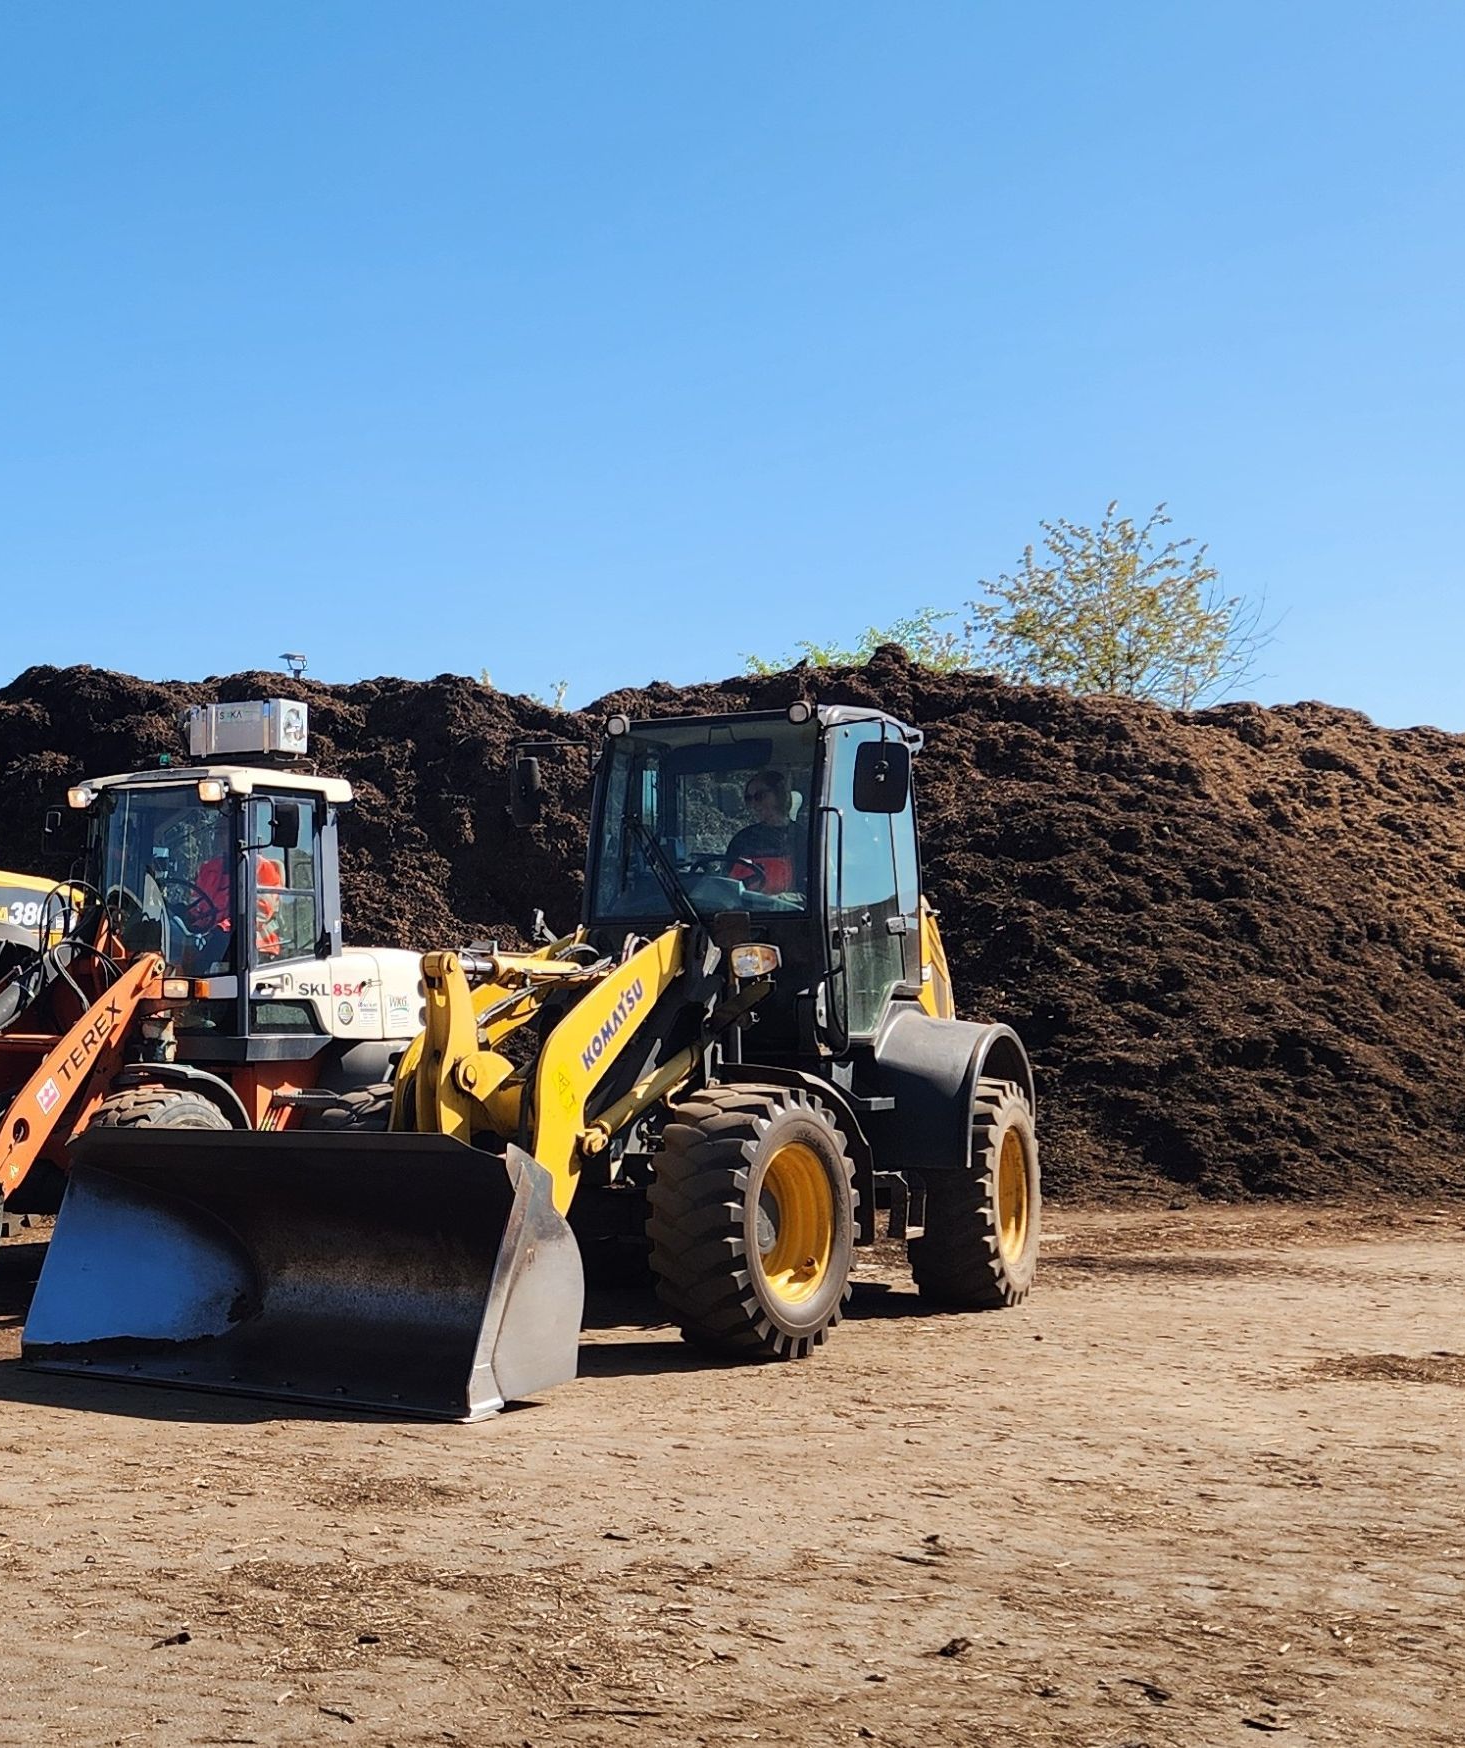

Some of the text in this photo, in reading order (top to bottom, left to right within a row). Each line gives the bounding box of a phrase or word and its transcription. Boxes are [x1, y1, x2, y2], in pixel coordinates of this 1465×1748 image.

[298, 983, 363, 997] SKL 854
[581, 976, 643, 1073] KOMATSU
[57, 996, 123, 1081] TEREX
